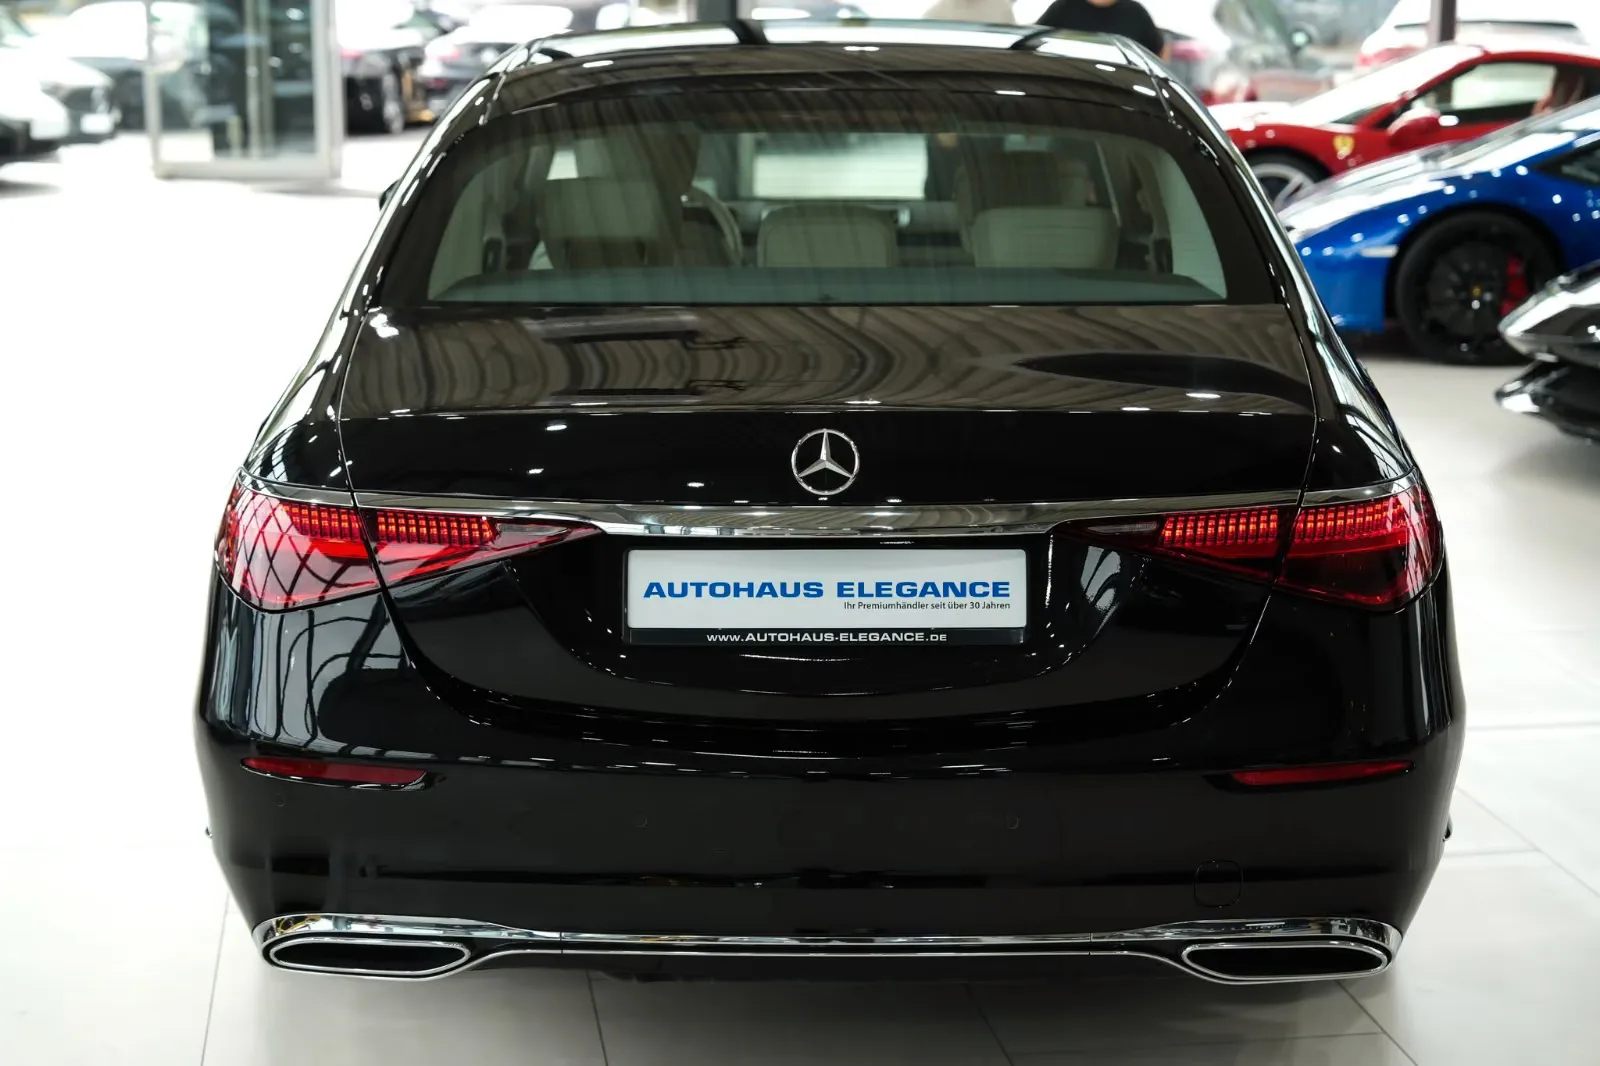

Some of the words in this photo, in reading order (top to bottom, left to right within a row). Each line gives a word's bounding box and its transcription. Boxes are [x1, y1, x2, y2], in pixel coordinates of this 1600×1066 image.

[643, 581, 824, 598] AUTOHAUS
[836, 581, 1011, 598] ELEGANCE
[844, 601, 856, 610] Ihr
[857, 601, 929, 610] Premiumhändler
[931, 601, 946, 610] seit
[947, 601, 968, 610] über
[969, 601, 980, 610] 30
[981, 601, 1011, 610] Jahren
[706, 632, 947, 642] www.AUTOHAUS-ELEGANCE.DE
